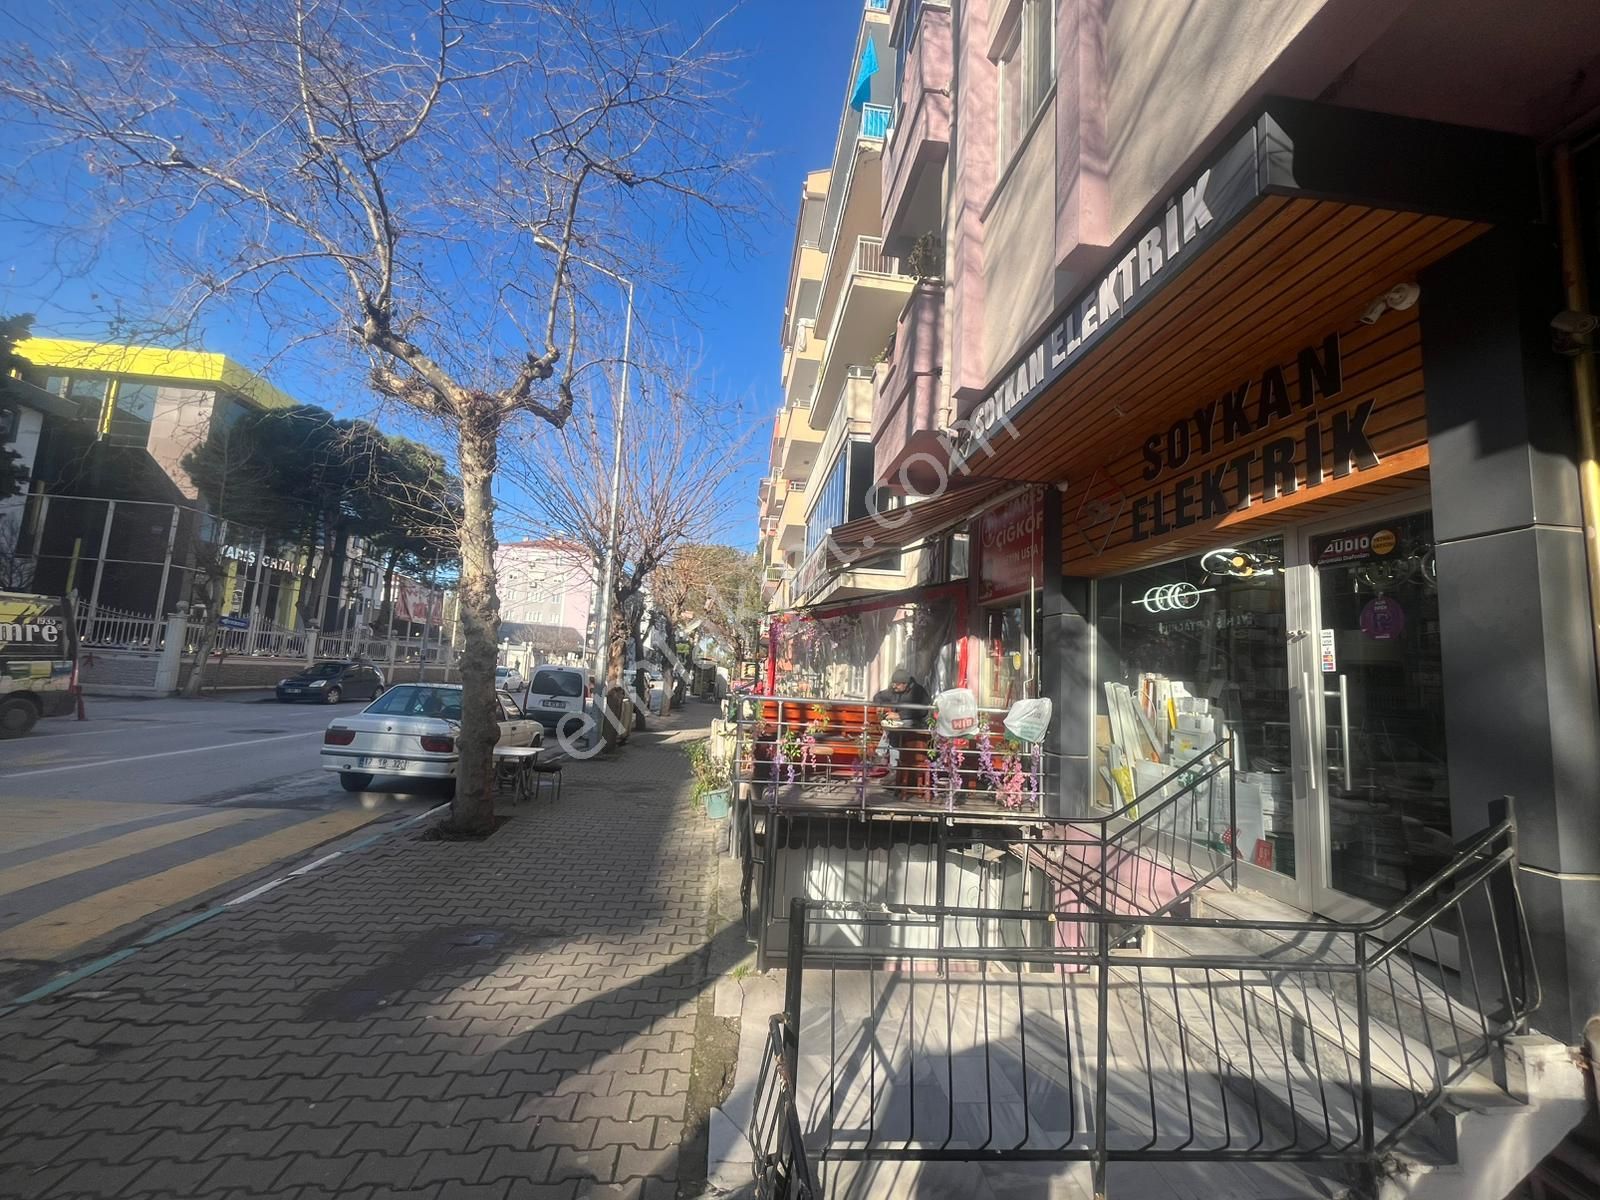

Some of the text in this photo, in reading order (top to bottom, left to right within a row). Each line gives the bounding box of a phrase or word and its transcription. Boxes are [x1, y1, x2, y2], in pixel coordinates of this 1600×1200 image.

[974, 168, 1213, 440] SOYKAN ELEKTRİK
[1132, 398, 1380, 542] ELEKTRİK
[1143, 330, 1342, 481] SOYKAN
[1324, 537, 1369, 554] AUDIO
